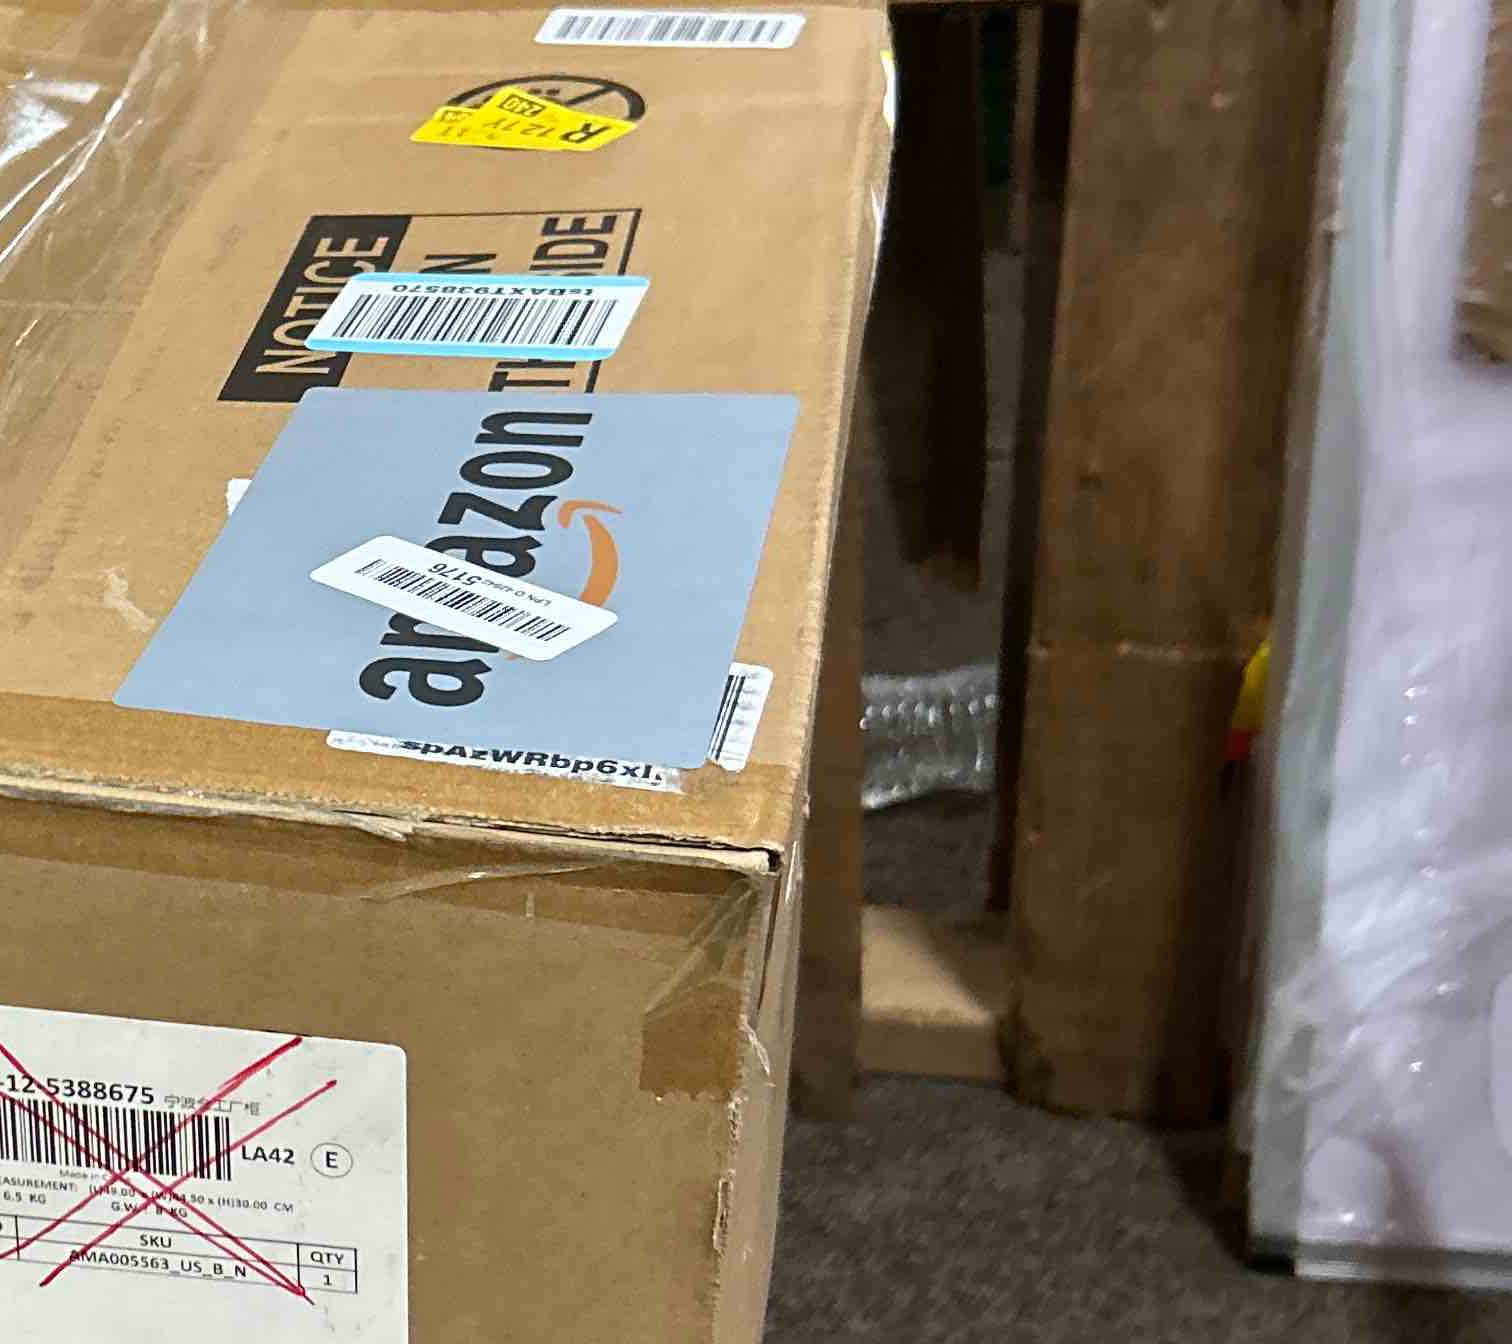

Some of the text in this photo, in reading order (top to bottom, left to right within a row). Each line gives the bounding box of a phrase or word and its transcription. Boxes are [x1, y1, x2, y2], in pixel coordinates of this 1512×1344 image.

[530, 214, 618, 277] IDE
[241, 1145, 295, 1165] LA42
[325, 1151, 339, 1169] E
[139, 1233, 173, 1249] SKU
[309, 1250, 346, 1266] QTY
